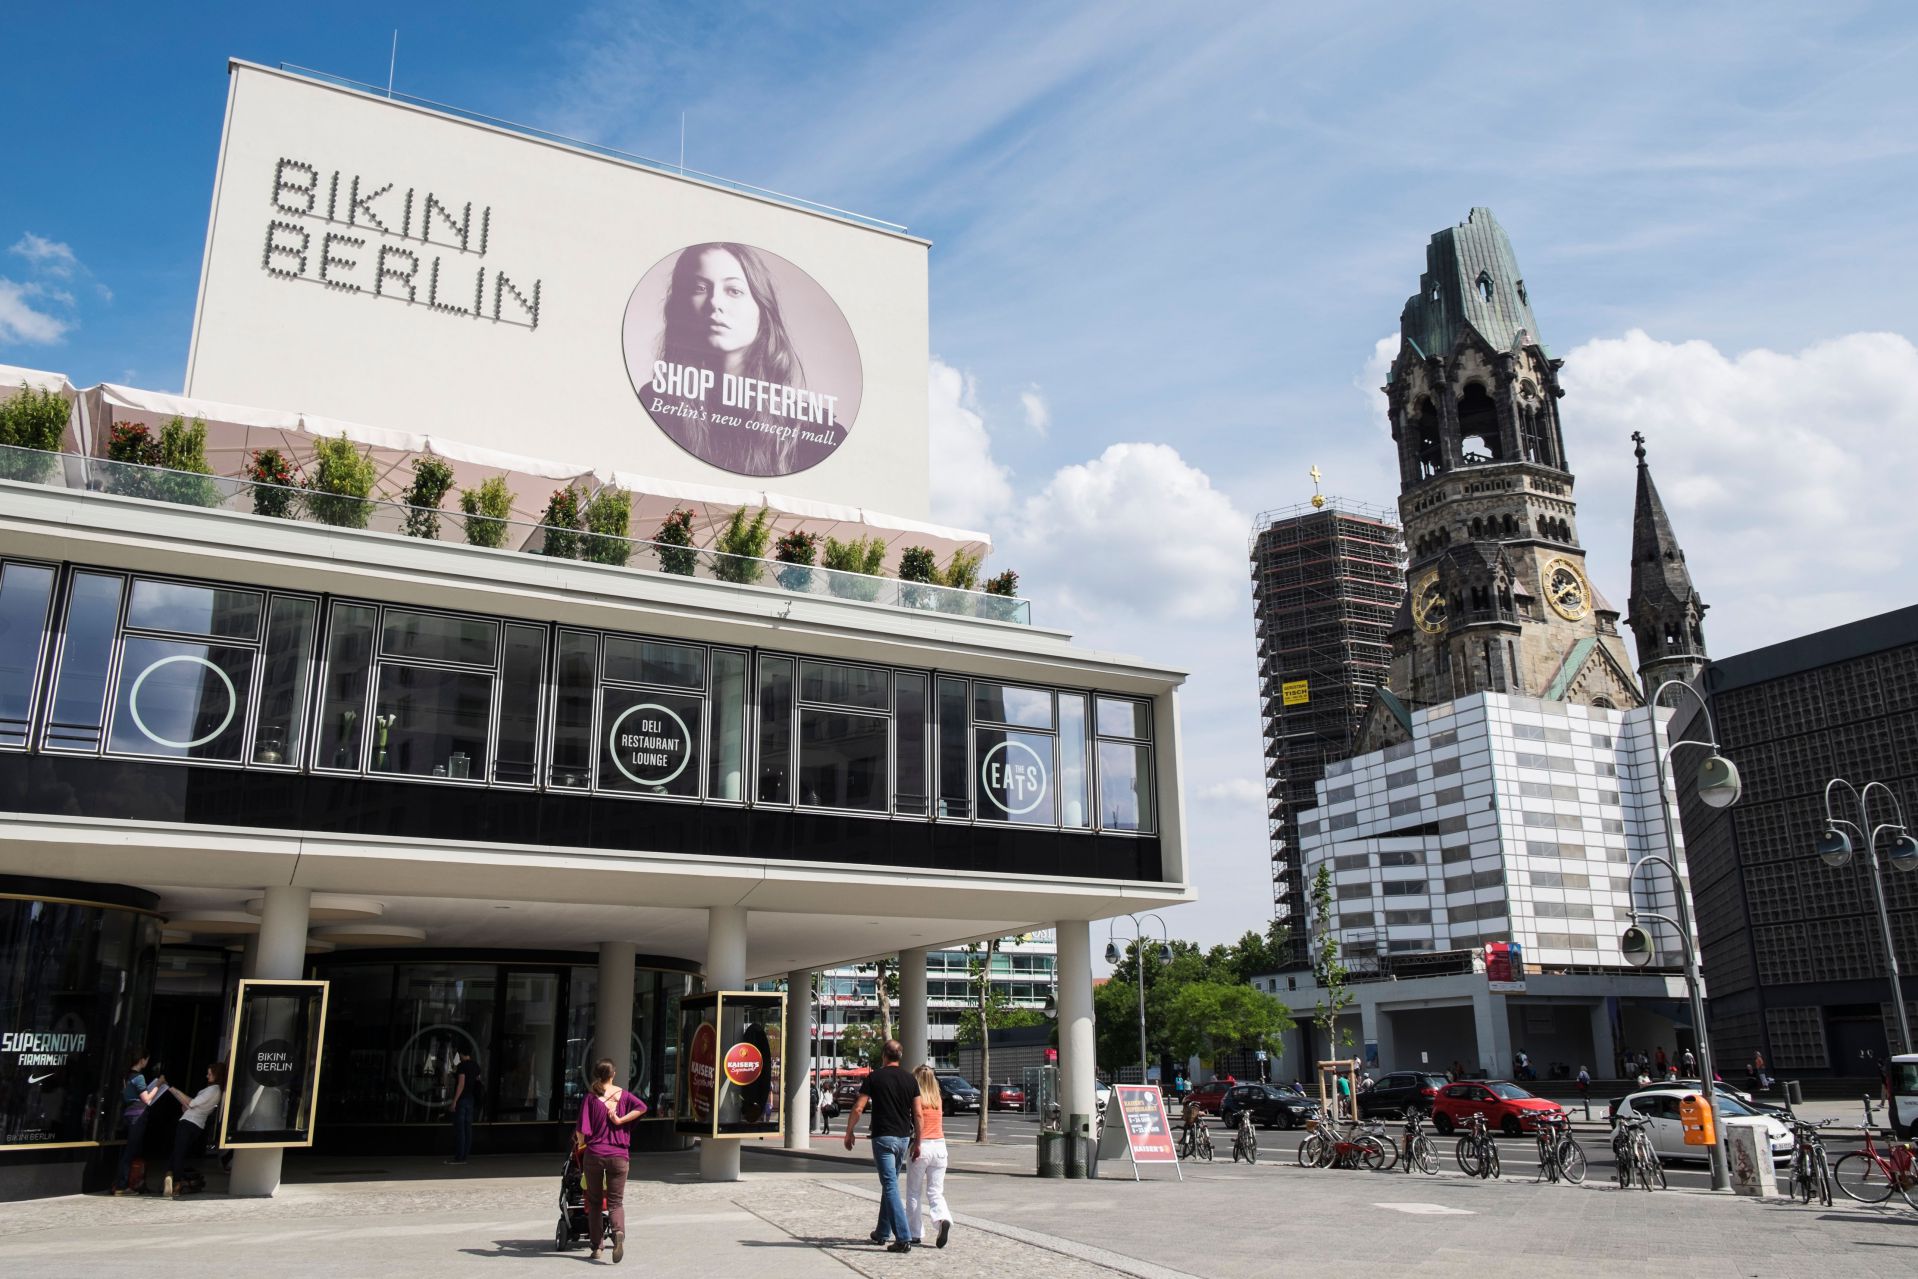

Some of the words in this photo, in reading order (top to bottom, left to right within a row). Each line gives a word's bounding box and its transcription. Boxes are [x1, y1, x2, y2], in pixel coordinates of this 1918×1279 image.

[272, 157, 491, 255] BIKINI
[263, 219, 541, 329] BERLIN
[652, 360, 715, 402] SHOP
[722, 373, 838, 427] DIFFERENT
[650, 397, 708, 421] Berlin's
[711, 412, 742, 427] new
[745, 419, 799, 441] concept
[801, 430, 837, 446] mall.
[642, 719, 662, 733] DELI
[621, 734, 680, 751] RESTAURANT
[632, 751, 668, 767] LOUNGE
[1014, 764, 1025, 774] THE
[991, 762, 1038, 801] EATS
[1, 1032, 87, 1052] SUPERNOVA
[18, 1053, 69, 1066] FIRMAMENT
[257, 1052, 287, 1061] BIKINI
[256, 1062, 293, 1071] BERLIN
[691, 1061, 715, 1079] KAISER'
[30, 1132, 56, 1141] BERLIN
